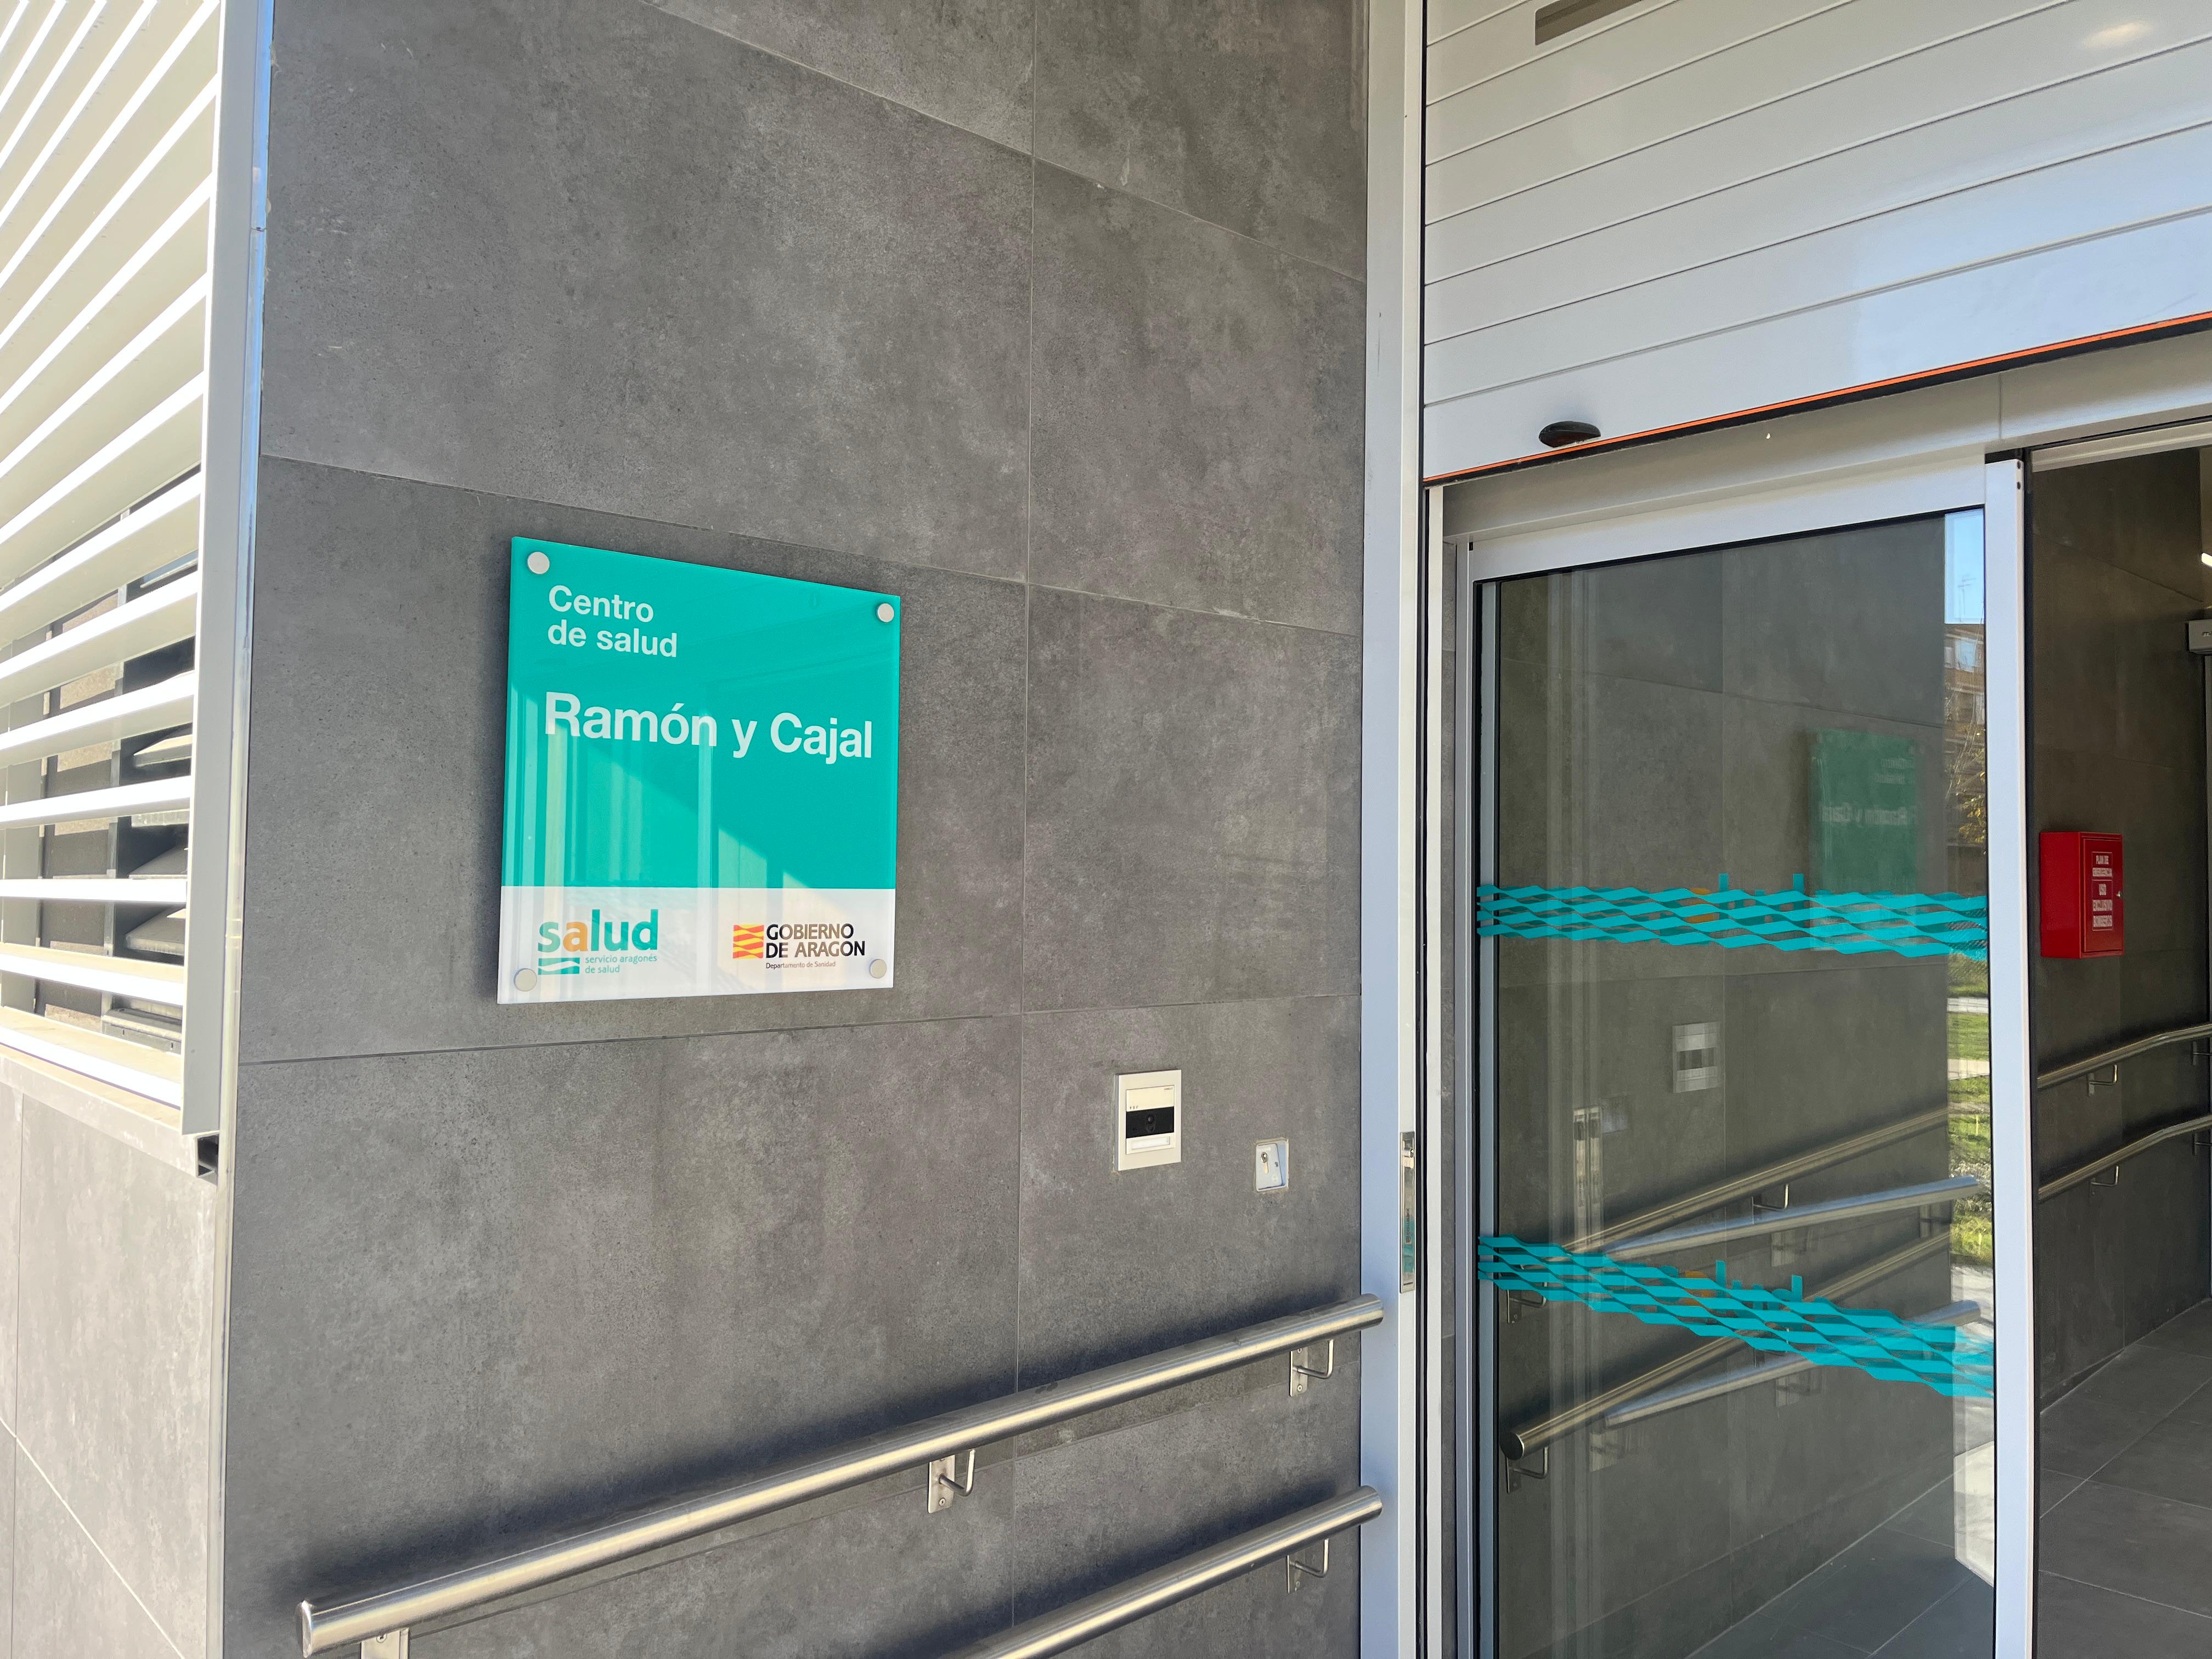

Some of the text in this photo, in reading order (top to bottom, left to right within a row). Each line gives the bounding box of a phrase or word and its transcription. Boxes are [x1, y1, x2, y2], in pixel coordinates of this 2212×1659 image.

[549, 585, 654, 623] Centro
[548, 619, 678, 658] de salud
[545, 691, 872, 765] Ramón y Cajal
[538, 909, 658, 953] salud
[766, 923, 854, 940] GOBIERNO
[585, 953, 657, 964] servicio aragonés
[766, 940, 865, 958] DE ARAGON
[585, 964, 620, 974] de salud
